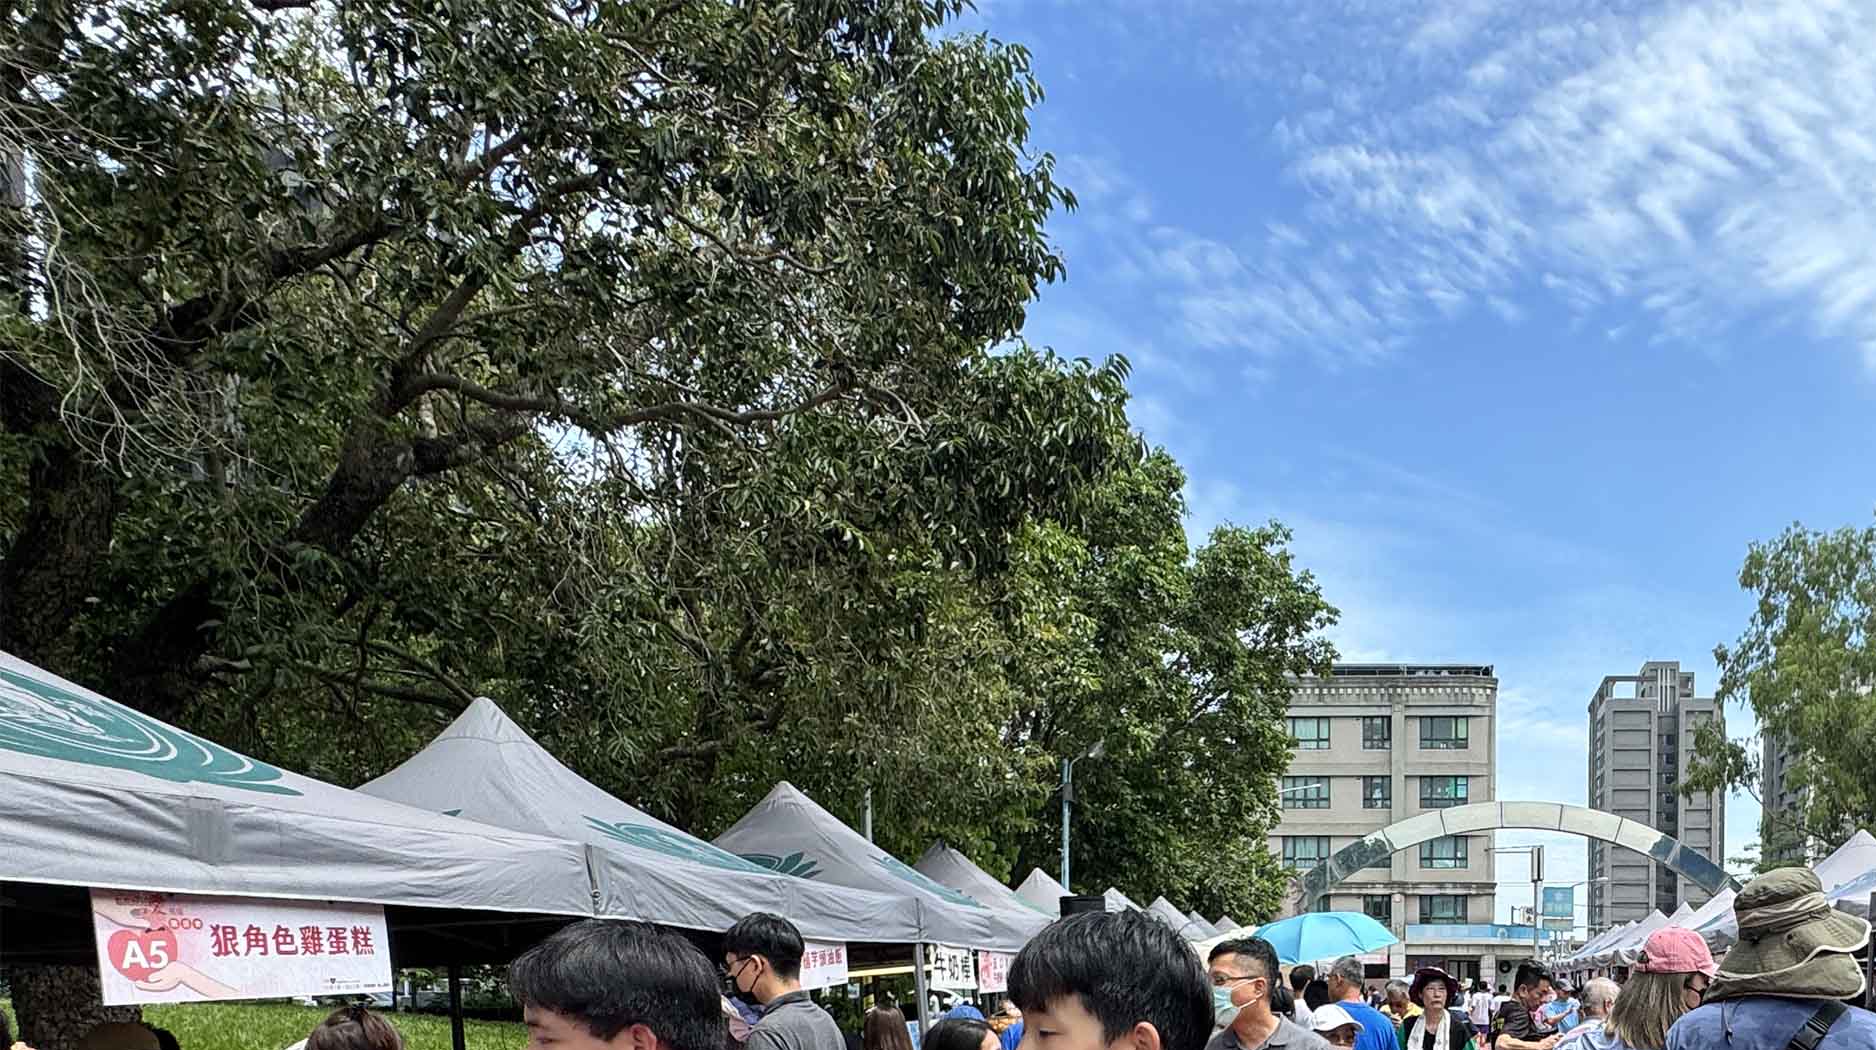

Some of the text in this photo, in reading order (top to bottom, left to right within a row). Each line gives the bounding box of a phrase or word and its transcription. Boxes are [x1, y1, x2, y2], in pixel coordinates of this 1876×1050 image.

[122, 940, 169, 969] A5
[209, 924, 375, 957] 狠角色雞蛋糕
